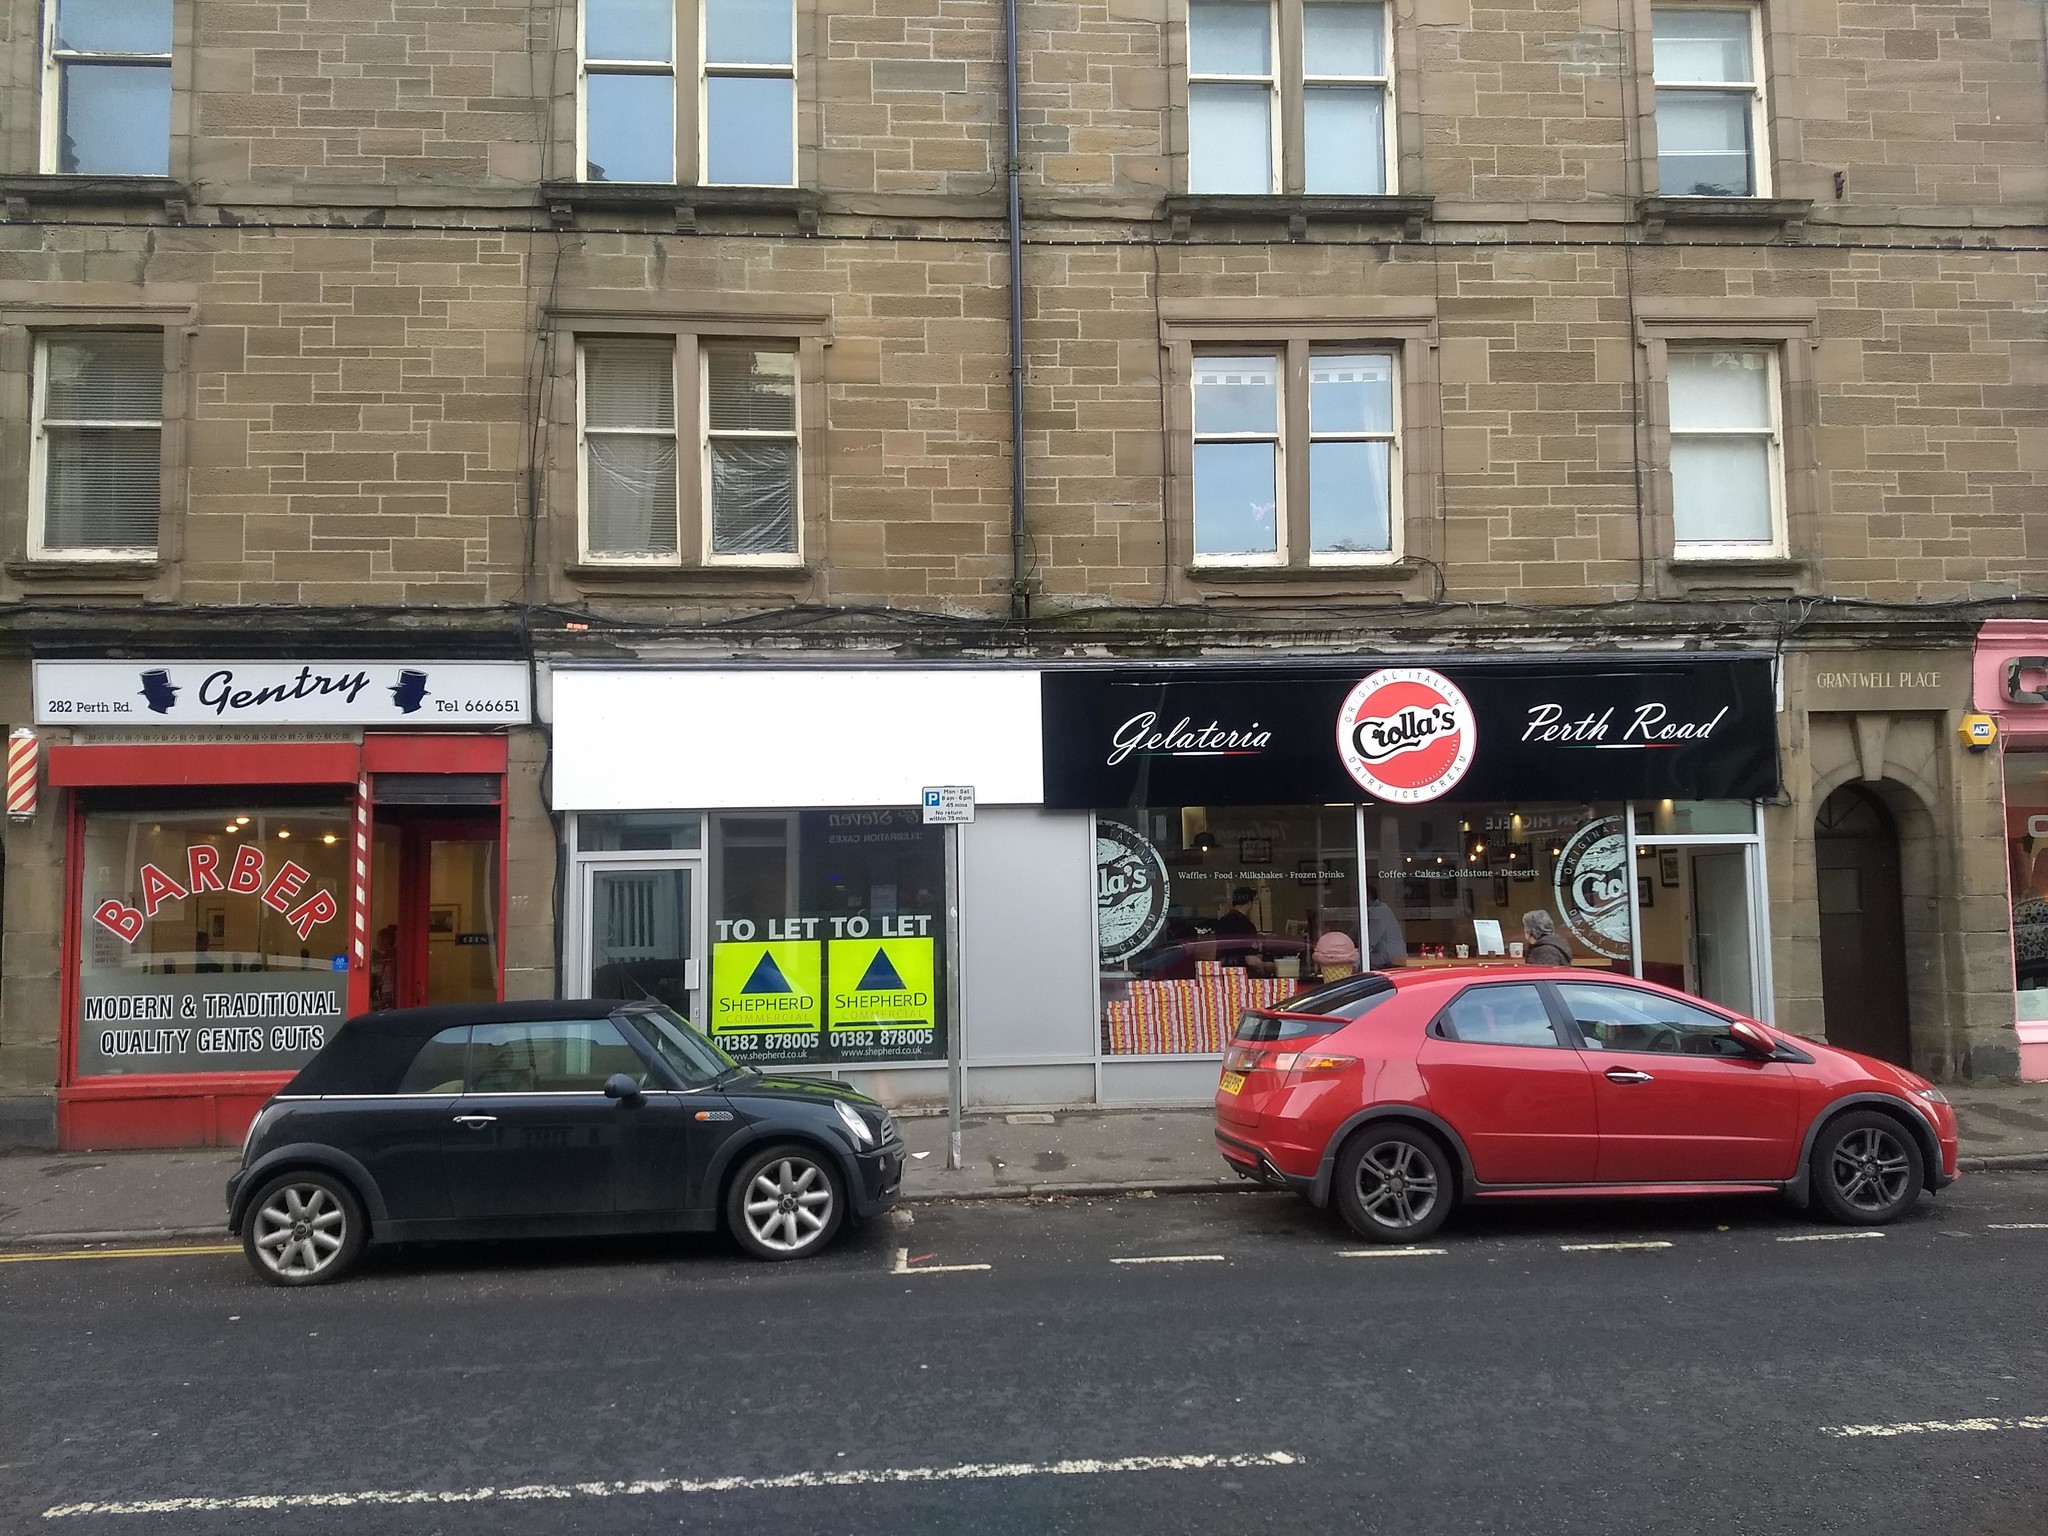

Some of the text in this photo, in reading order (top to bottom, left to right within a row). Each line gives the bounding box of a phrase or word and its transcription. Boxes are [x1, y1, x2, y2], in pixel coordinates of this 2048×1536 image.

[1816, 671, 1941, 688] GRANTWELL PLACE
[199, 665, 370, 716] Gentry
[1344, 671, 1460, 723] ORIGINAL ITALIAN
[48, 700, 133, 713] 282 Perth Rd.
[435, 700, 520, 712] Tel 666651
[1521, 703, 1729, 742] Perth Road
[1974, 725, 1990, 735] ADT
[1107, 711, 1272, 766] Gelateria
[1352, 708, 1455, 760] Crolla's
[1348, 755, 1467, 798] DAIRY ICE CREAM
[928, 793, 938, 805] P
[1564, 825, 1619, 875] ORIGINAL
[1098, 864, 1147, 897] la's
[1178, 870, 1345, 880] Waffles Food Milkshakes Frozen Drinks
[1378, 868, 1540, 878] Coffee Cakes Coldstone Desserts
[92, 844, 338, 944] BARBER
[715, 918, 819, 941] TO LET
[830, 915, 932, 938] TO LET
[1119, 913, 1158, 952] CREAM
[84, 990, 342, 1021] MODERN & TRADITIONAL
[720, 996, 814, 1012] SHEPHERD
[835, 992, 928, 1009] SHEPHERD
[726, 1013, 809, 1023] COMMERCIAL
[842, 1009, 923, 1020] COMMERCIAL
[100, 1024, 325, 1057] QUALITY GENTS CUTS
[713, 1033, 819, 1051] 01382 878005
[830, 1029, 934, 1047] 01382 878005
[841, 1046, 923, 1057] www.shepherd.co.uk
